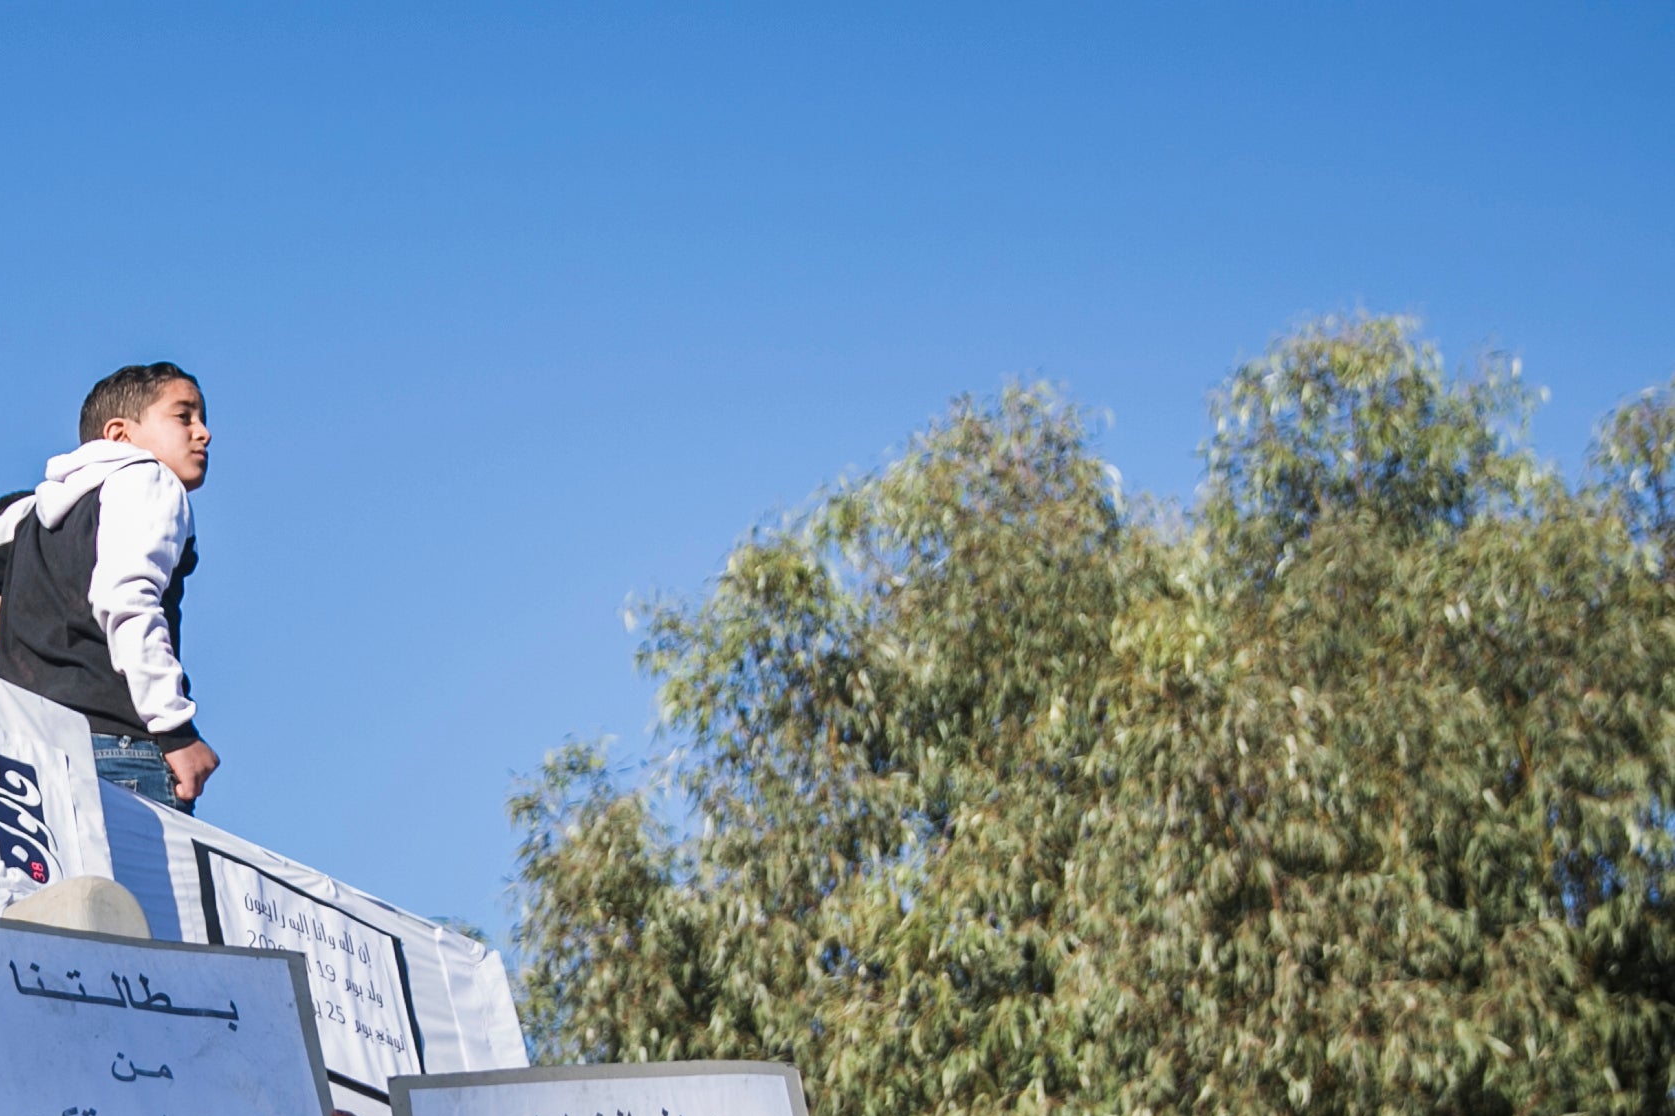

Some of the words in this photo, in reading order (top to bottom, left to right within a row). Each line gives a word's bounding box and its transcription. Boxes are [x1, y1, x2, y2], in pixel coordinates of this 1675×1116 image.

[30, 861, 47, 884] 38
[316, 960, 336, 983] 19
[8, 959, 241, 1032] بطالتنا
[345, 979, 364, 1002] يوم
[367, 980, 384, 1008] ولد
[326, 1000, 346, 1024] 25
[354, 1020, 374, 1044] يوم
[111, 1051, 174, 1083] من
